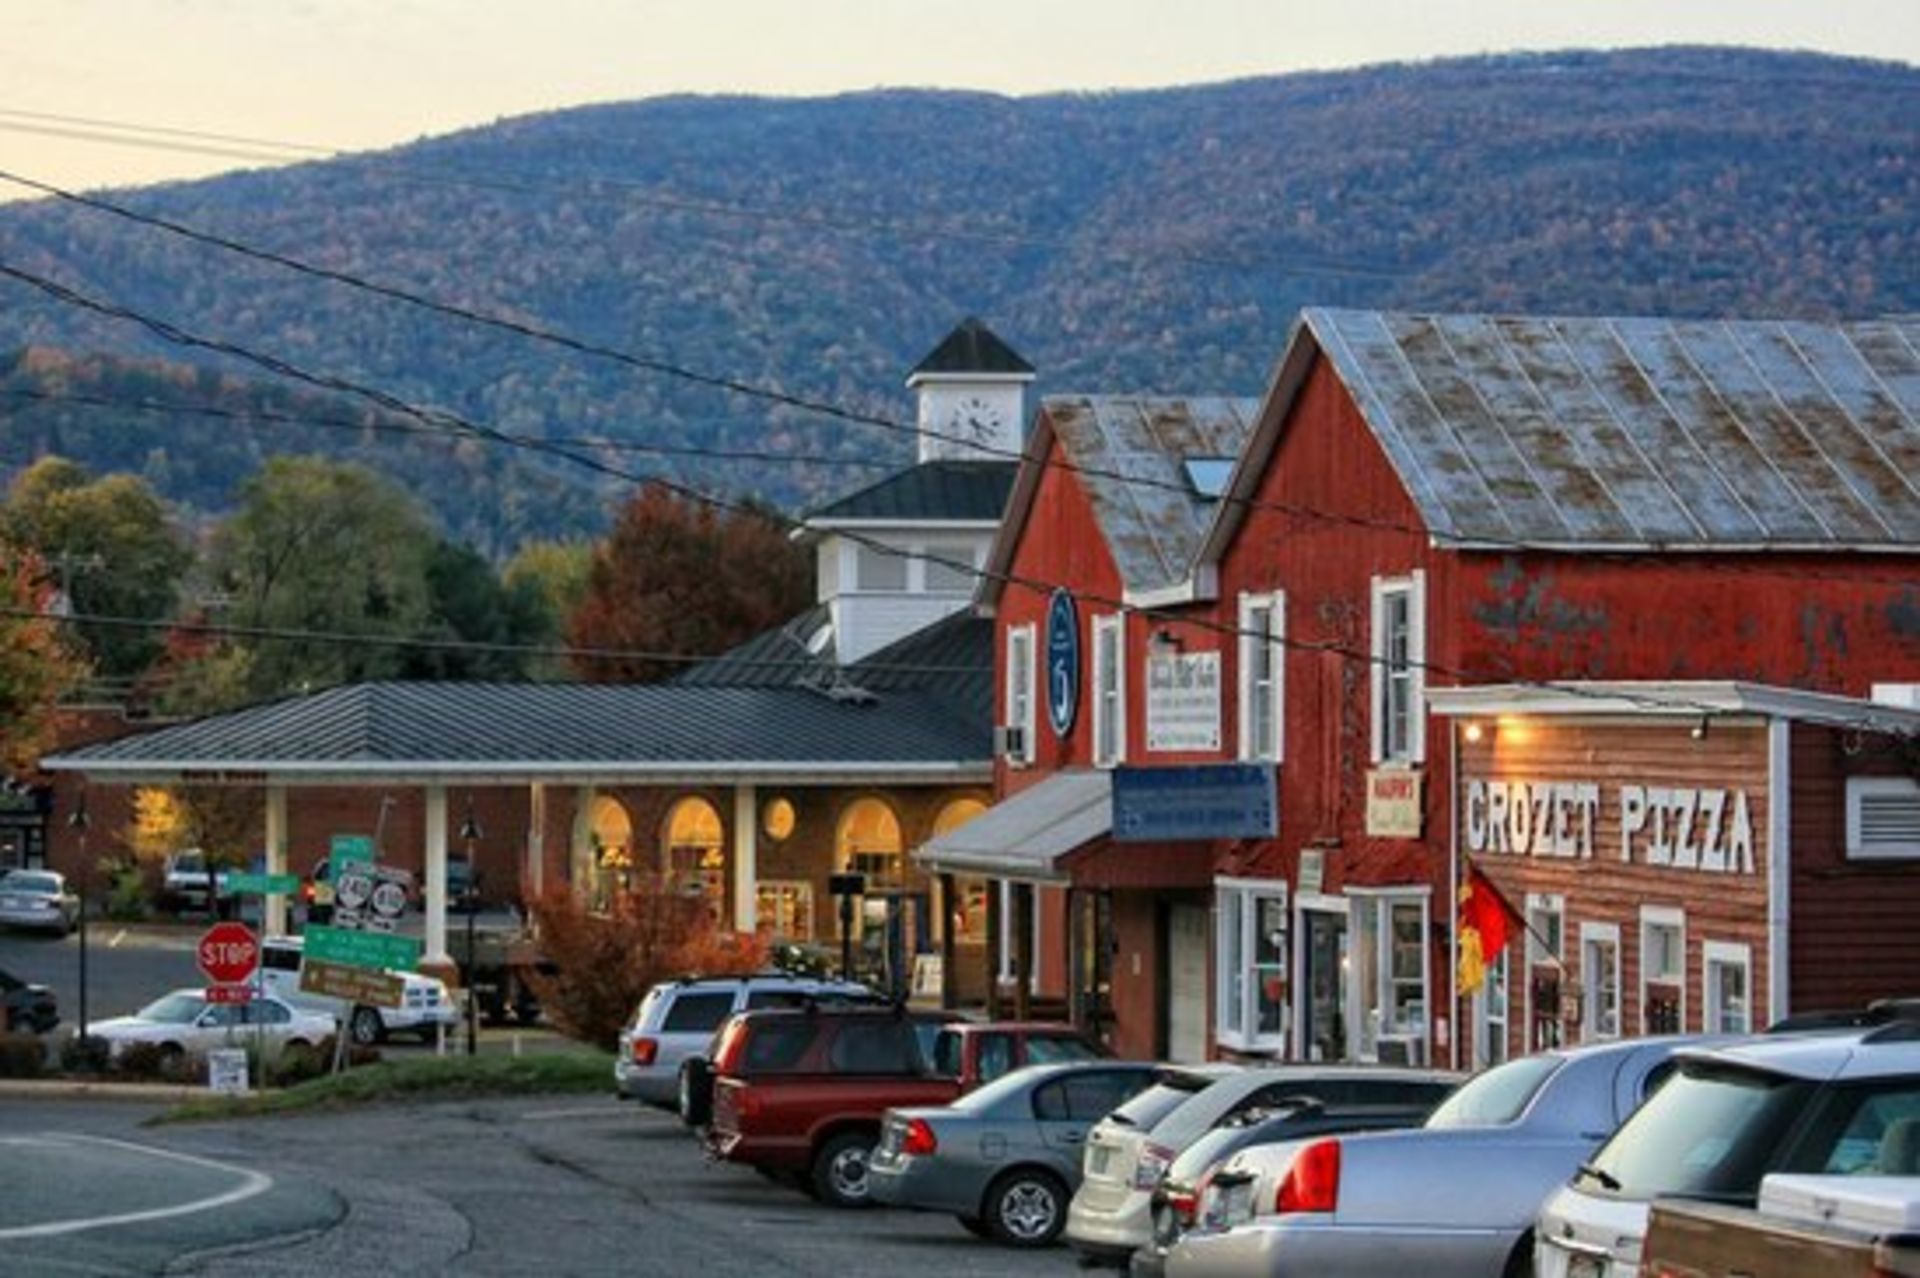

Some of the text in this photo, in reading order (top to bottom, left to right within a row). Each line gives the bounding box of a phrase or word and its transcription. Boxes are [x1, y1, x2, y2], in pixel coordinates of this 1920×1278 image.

[1467, 780, 1754, 873] CROZET PIZZA
[203, 942, 254, 965] STOP
